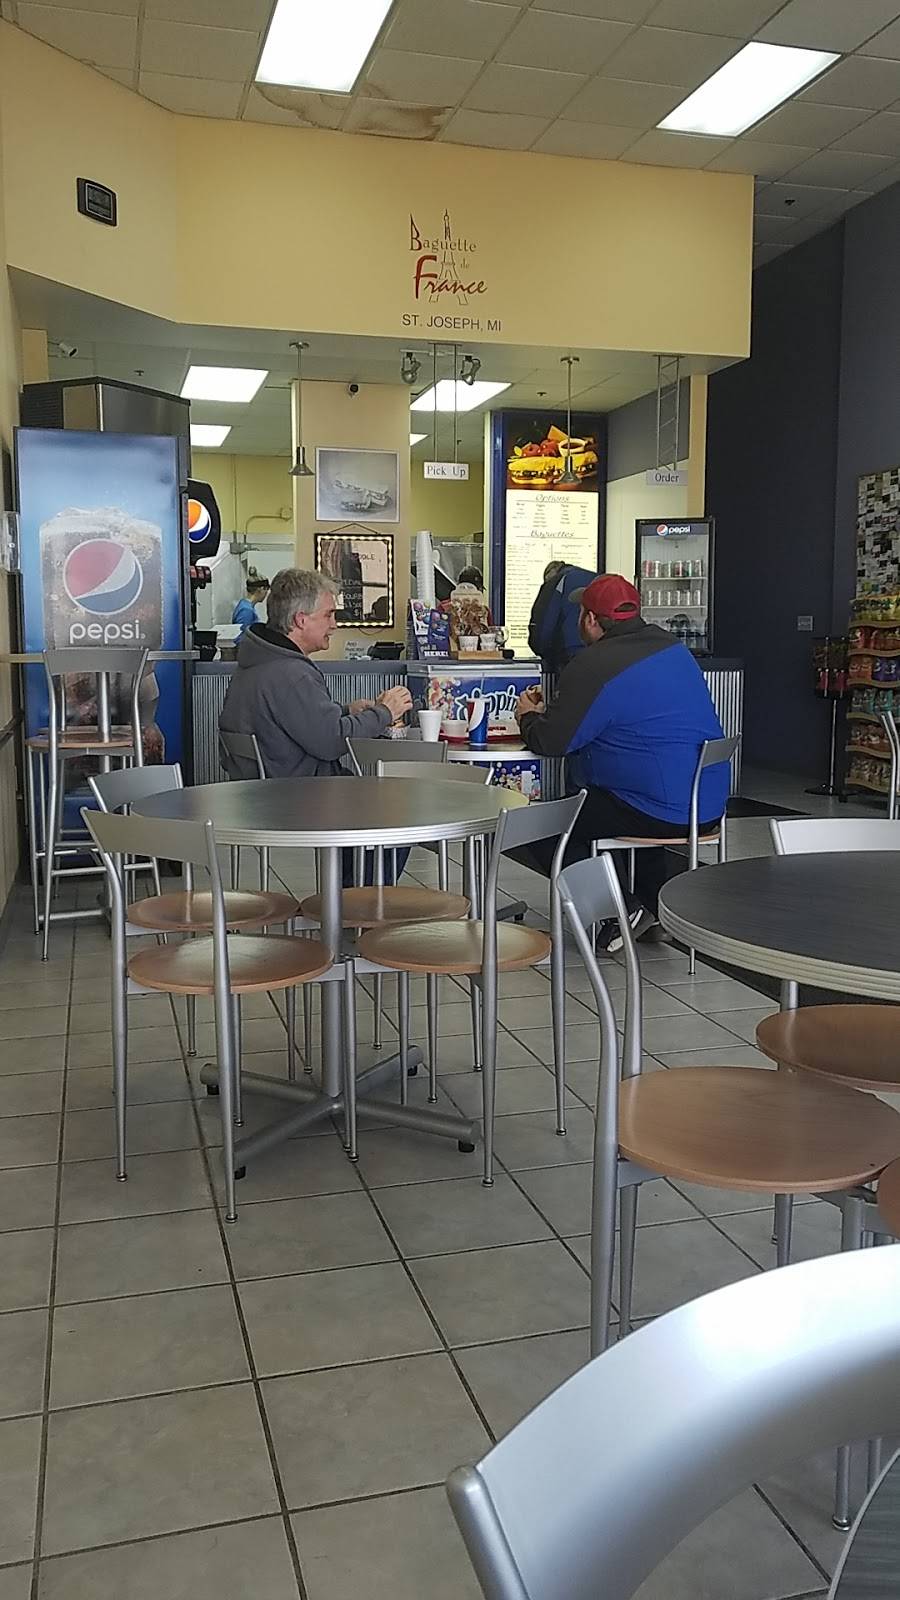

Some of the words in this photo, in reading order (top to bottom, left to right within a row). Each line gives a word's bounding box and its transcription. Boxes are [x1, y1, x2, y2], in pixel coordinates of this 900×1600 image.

[409, 213, 477, 253] Baguette
[413, 254, 488, 299] France
[402, 313, 423, 327] ST.
[427, 315, 483, 332] JOSEPH,
[487, 319, 501, 331] MI
[427, 465, 447, 476] Pick
[452, 466, 466, 478] Up
[655, 473, 679, 482] Order
[668, 525, 691, 534] pepsi
[69, 619, 140, 644] pepsi
